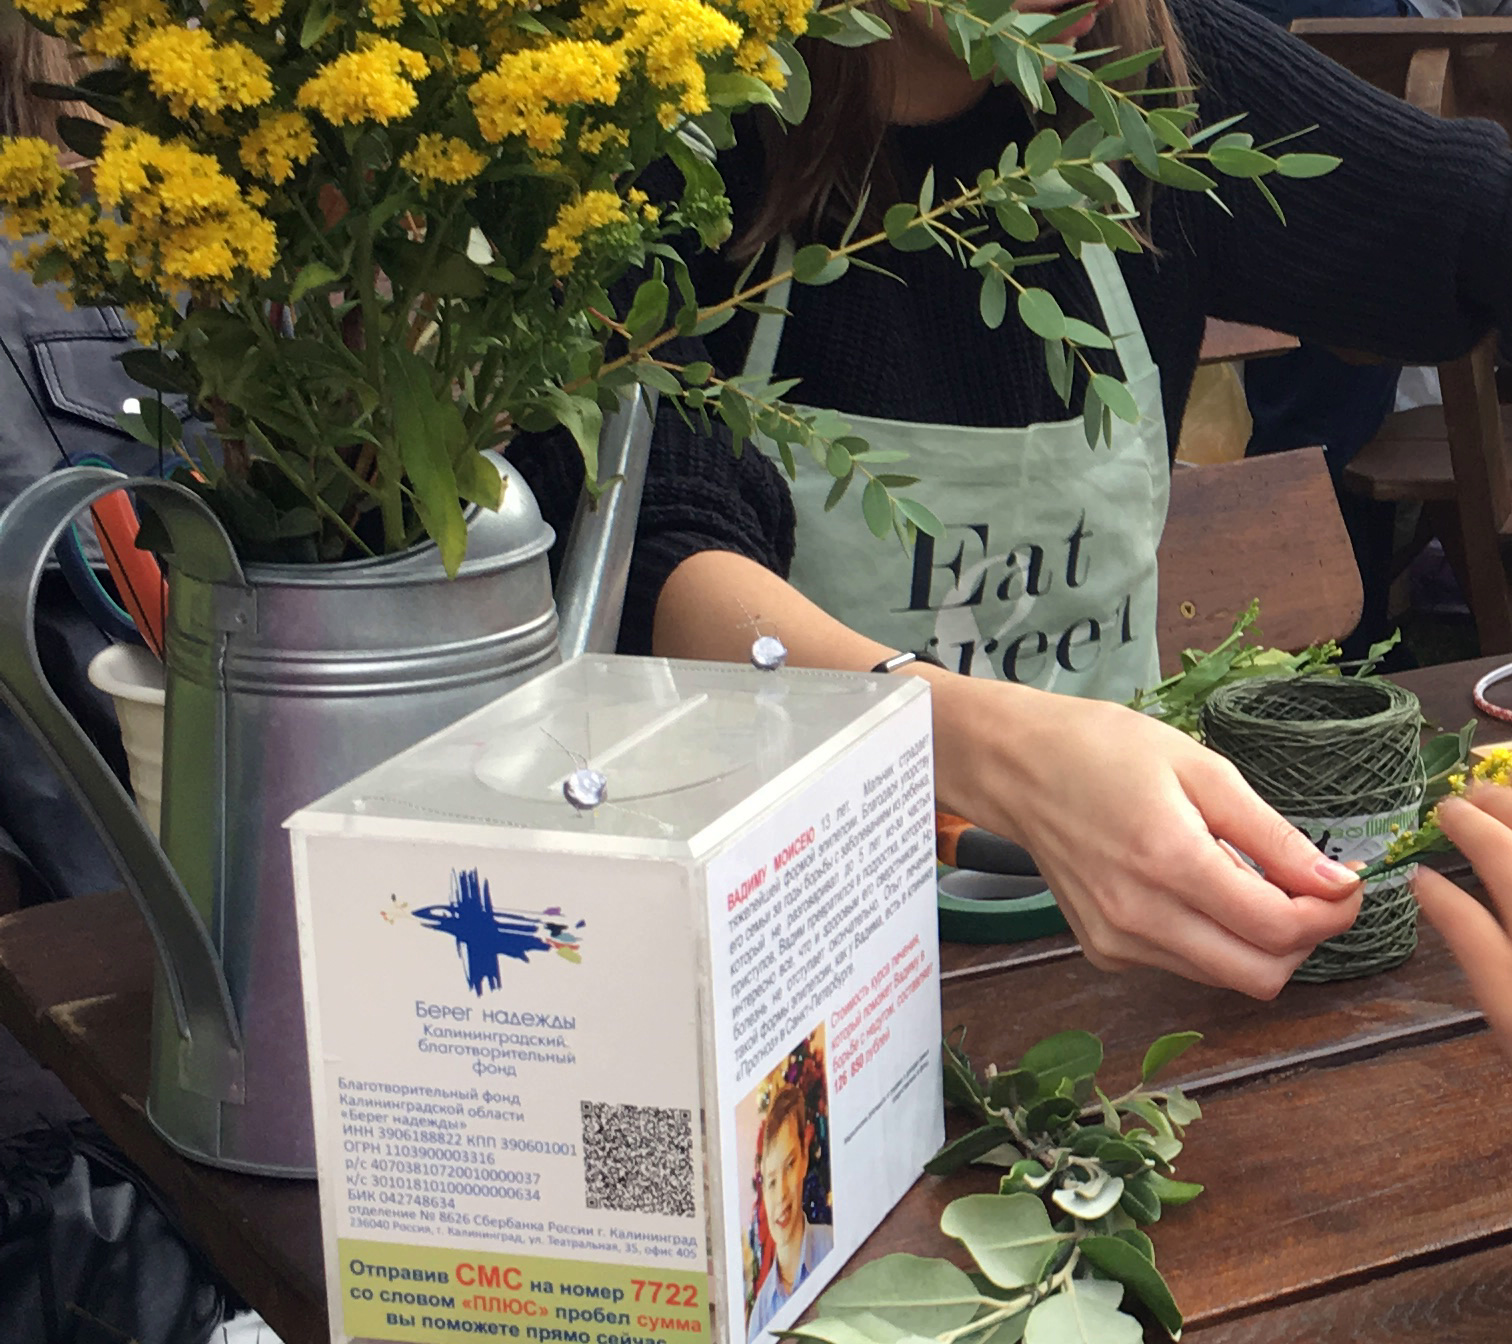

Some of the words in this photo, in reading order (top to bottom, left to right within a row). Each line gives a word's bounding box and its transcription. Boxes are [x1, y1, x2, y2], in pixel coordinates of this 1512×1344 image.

[890, 508, 1093, 613] Eat
[726, 862, 768, 915] ВАДИМУ
[773, 823, 816, 875] МОИСЕЮ
[820, 809, 831, 834] 13
[858, 844, 864, 865] 5
[414, 999, 474, 1022] Берег
[482, 1007, 576, 1031] надежды
[422, 1022, 566, 1052] Калининградский
[417, 1037, 576, 1068] благотворительный
[471, 1058, 517, 1080] фонд
[337, 1076, 479, 1103] Благотворительный
[481, 1091, 520, 1107] фонд
[338, 1092, 464, 1118] Калининградской
[466, 1104, 524, 1122] области
[339, 1108, 388, 1124] «Берег
[392, 1113, 467, 1132] надежды»
[342, 1123, 374, 1138] ИНН
[377, 1126, 462, 1146] 3906188822
[466, 1134, 496, 1149] КПП
[499, 1136, 577, 1157] 390601001
[343, 1139, 381, 1155] ОГРН
[384, 1142, 495, 1165] 1103900003316
[344, 1156, 367, 1172] р/с
[369, 1158, 541, 1186] 40703810720010000037
[345, 1172, 367, 1187] к/с
[371, 1174, 541, 1202] 30101810100000000634
[347, 1188, 376, 1203] БИК
[378, 1190, 455, 1210] 042748634
[347, 1203, 417, 1220] отделение
[419, 1208, 436, 1221] №
[438, 1210, 470, 1225] 8626
[472, 1212, 544, 1233] Сбербанка
[547, 1220, 594, 1236] России
[609, 1226, 698, 1247] Калининград
[348, 1258, 449, 1287] Отправив
[454, 1261, 523, 1291] СМС
[529, 1279, 554, 1294] на
[559, 1282, 625, 1303] номер
[630, 1278, 699, 1308] 7722
[349, 1286, 374, 1301] со
[378, 1289, 455, 1308] словом
[461, 1293, 549, 1317] «ПЛЮС»
[554, 1303, 630, 1328] пробел
[636, 1313, 702, 1336] сумма
[386, 1312, 415, 1327] вы
[421, 1315, 520, 1337] поможете
